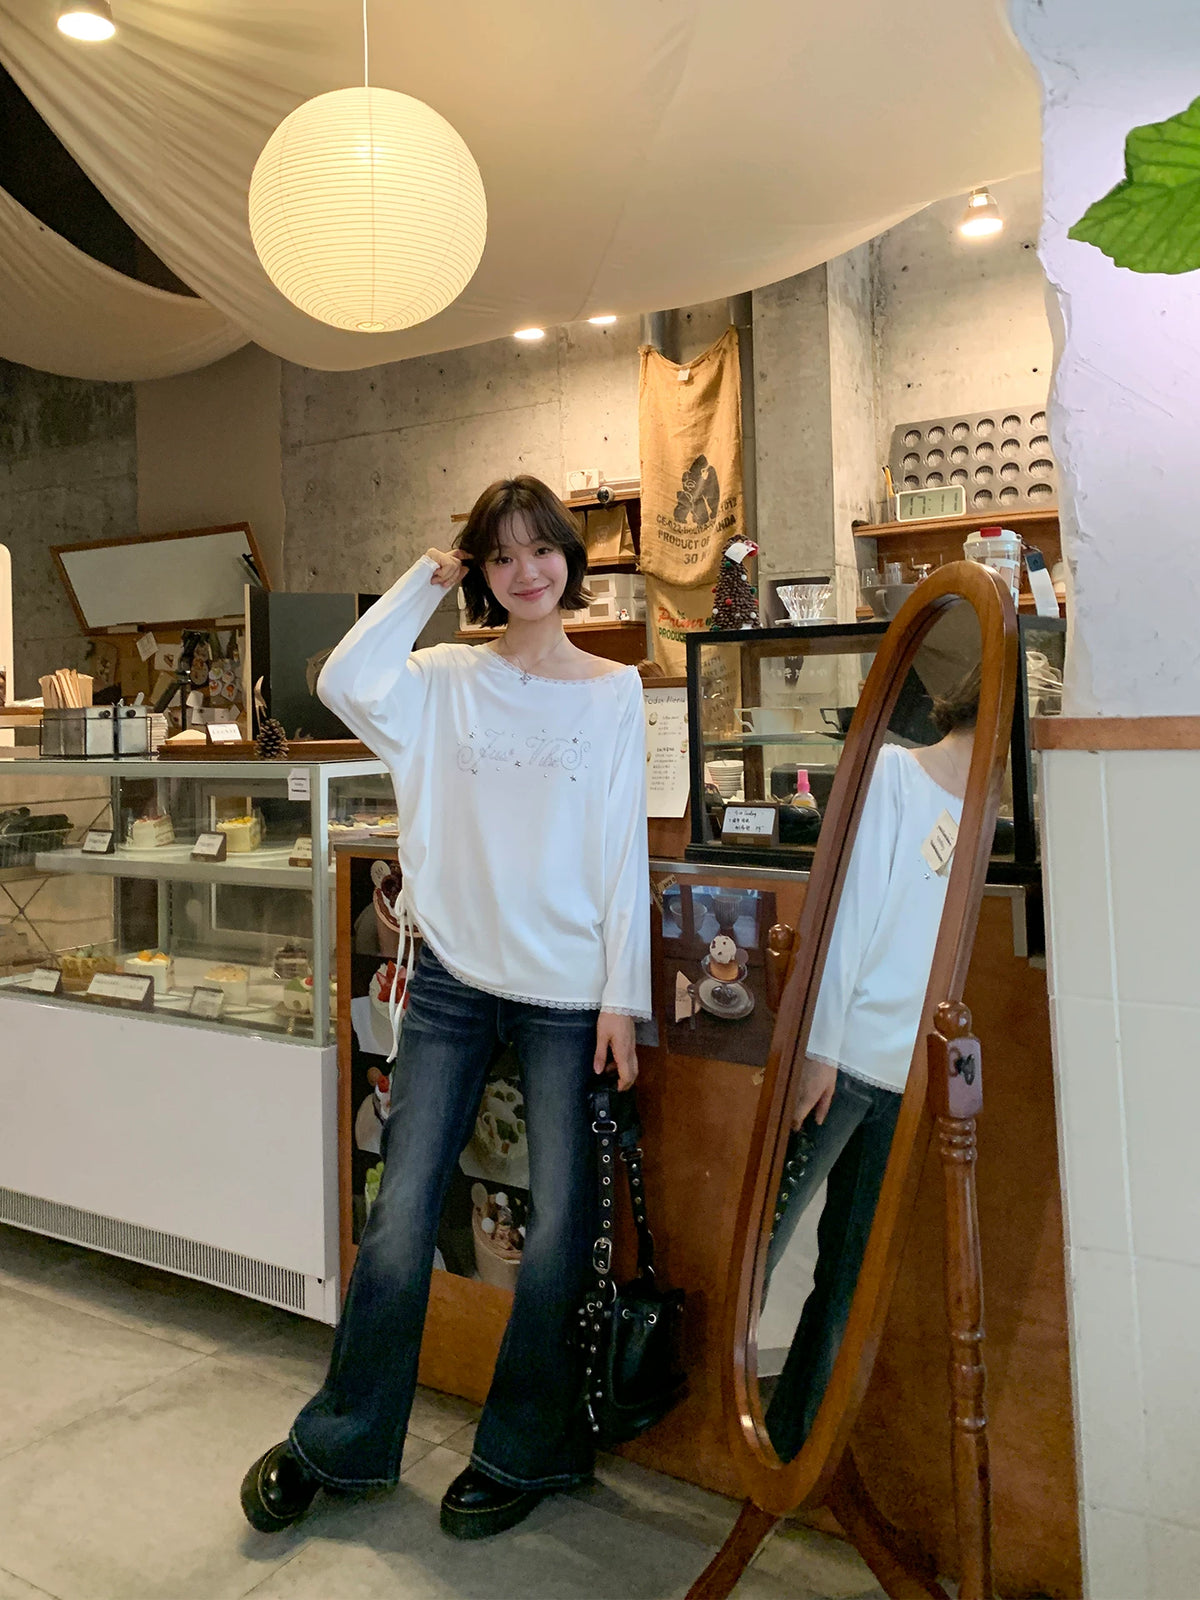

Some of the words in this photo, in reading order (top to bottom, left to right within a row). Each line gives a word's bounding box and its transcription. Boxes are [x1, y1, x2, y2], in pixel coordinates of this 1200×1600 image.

[909, 492, 958, 515] 17:11
[657, 529, 699, 550] PRODUCT
[700, 536, 711, 548] OF
[683, 553, 698, 565] 30
